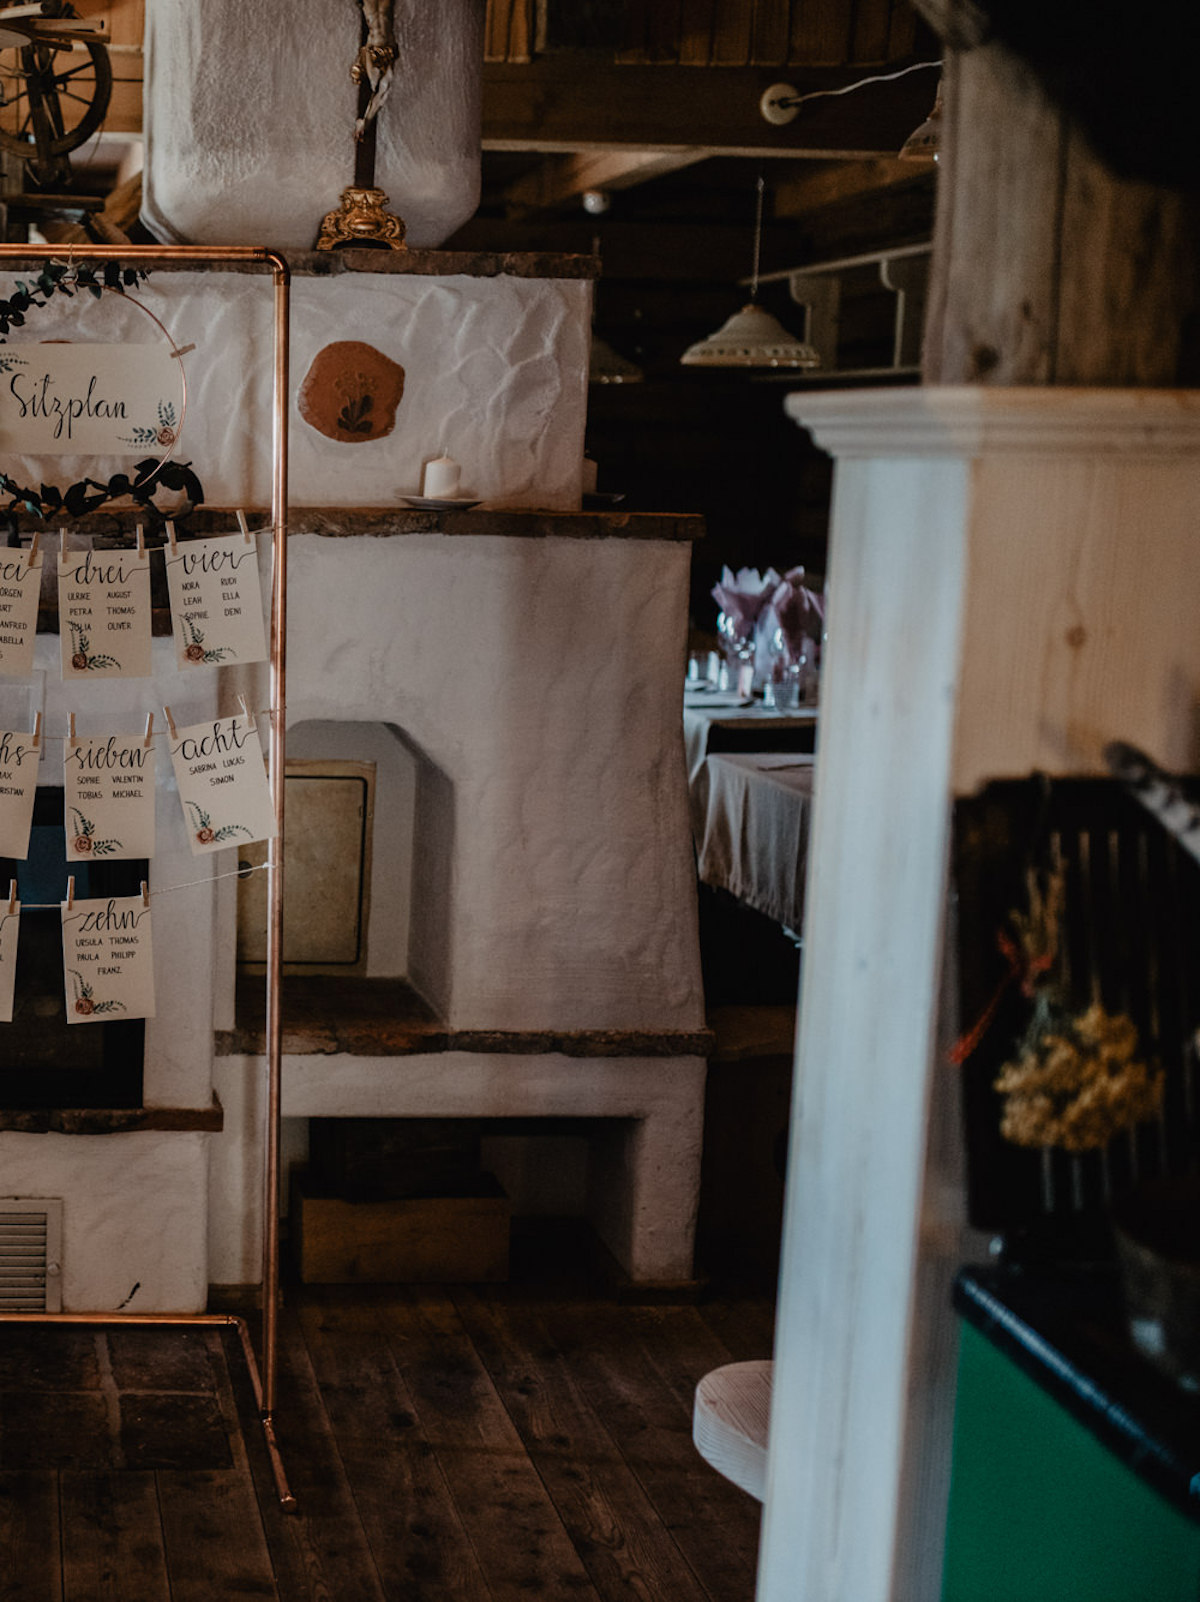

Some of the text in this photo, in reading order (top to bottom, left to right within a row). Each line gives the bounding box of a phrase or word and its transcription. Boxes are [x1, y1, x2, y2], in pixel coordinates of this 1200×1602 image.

[10, 373, 129, 439] Sitzplan
[166, 544, 258, 575] vier
[57, 550, 150, 585] drei
[182, 577, 237, 591] NORA RUDI
[67, 591, 132, 601] ULRIKE AUGUST
[183, 591, 241, 606] LEAH ELLA
[69, 606, 136, 616] PETRA THOMAS
[184, 610, 209, 620] SOPHIE
[107, 622, 132, 631] OLIVER
[171, 719, 258, 760] acht
[64, 736, 157, 769] sieben
[189, 756, 246, 776] SABRINA LUKAS
[77, 775, 144, 785] SOPHIE VALENTIN
[209, 774, 235, 787] SIMON
[77, 790, 144, 800] TOBIAS MICHAEL
[63, 899, 151, 932] zehn
[75, 936, 139, 947] URSULA THOMAS
[77, 950, 137, 961] PAULA PHILIPP
[97, 965, 123, 976] FRANZ
